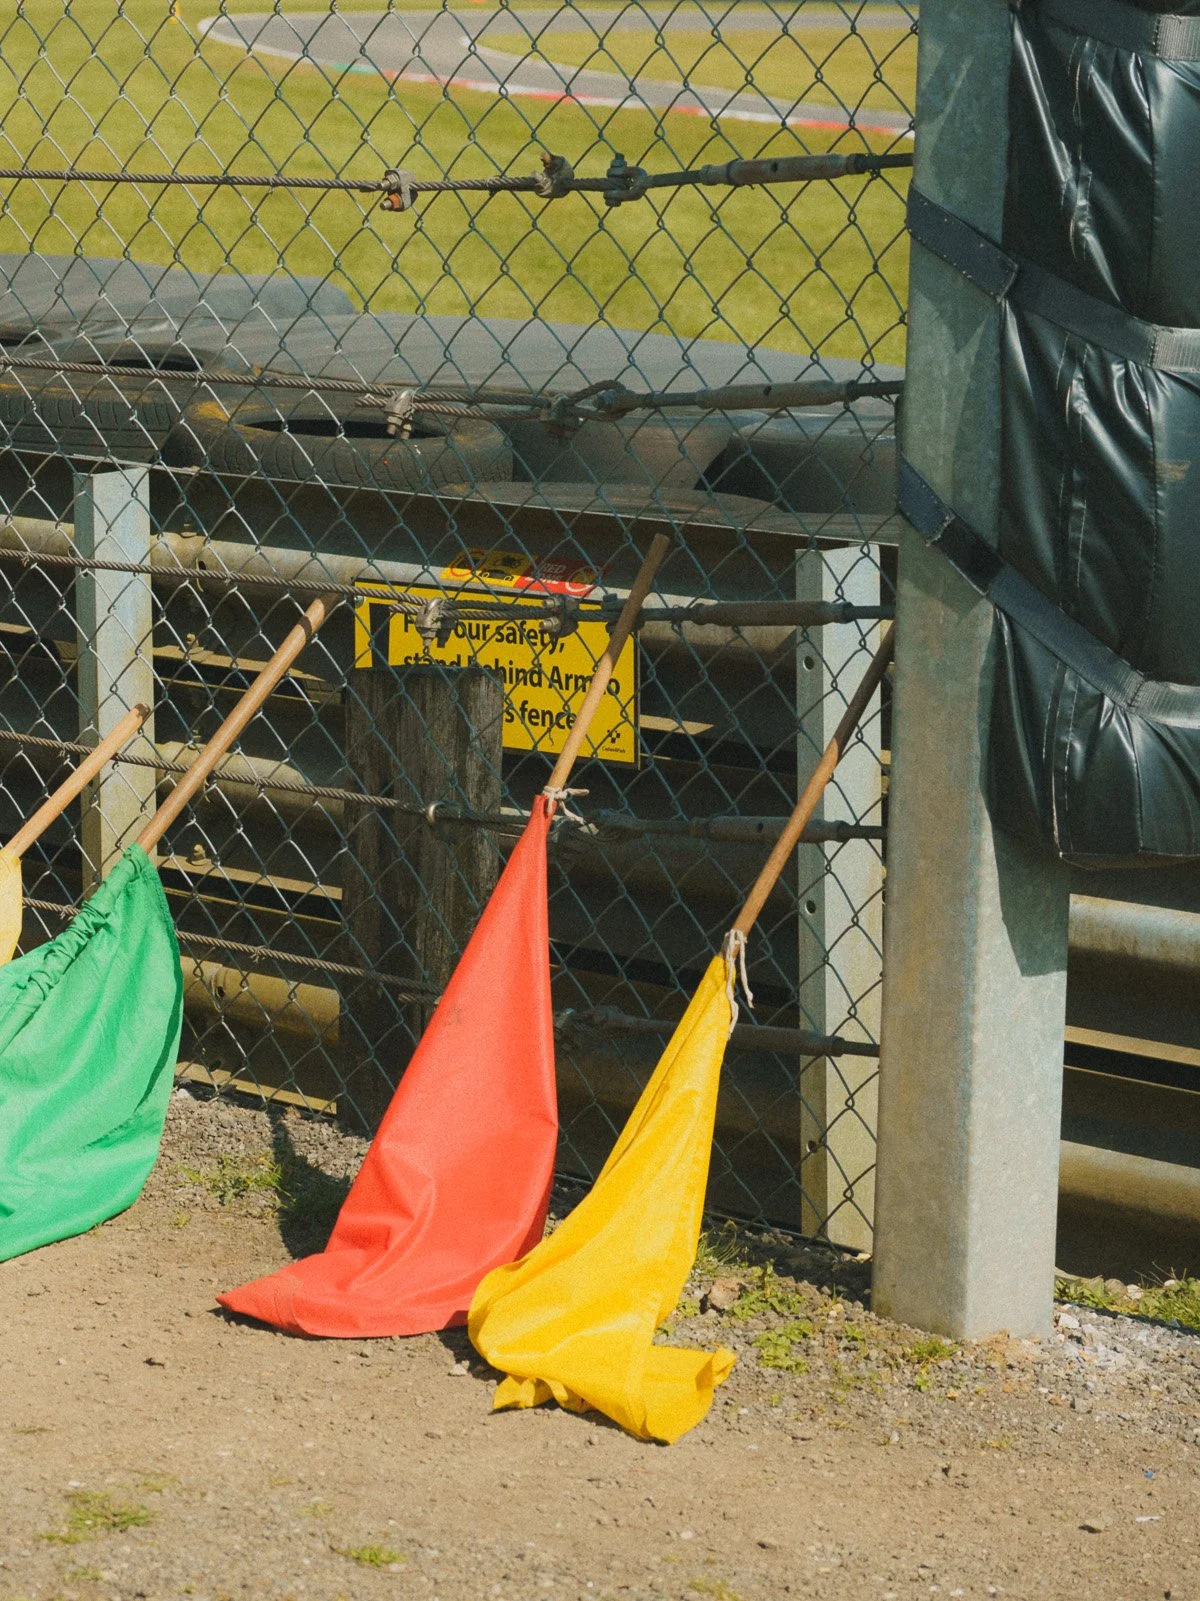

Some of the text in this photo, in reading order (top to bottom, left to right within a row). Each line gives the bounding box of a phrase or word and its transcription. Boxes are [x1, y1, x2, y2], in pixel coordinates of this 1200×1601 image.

[449, 622, 490, 641] our
[495, 621, 564, 654] safety,
[548, 666, 620, 696] Armo
[519, 700, 577, 730] fence
